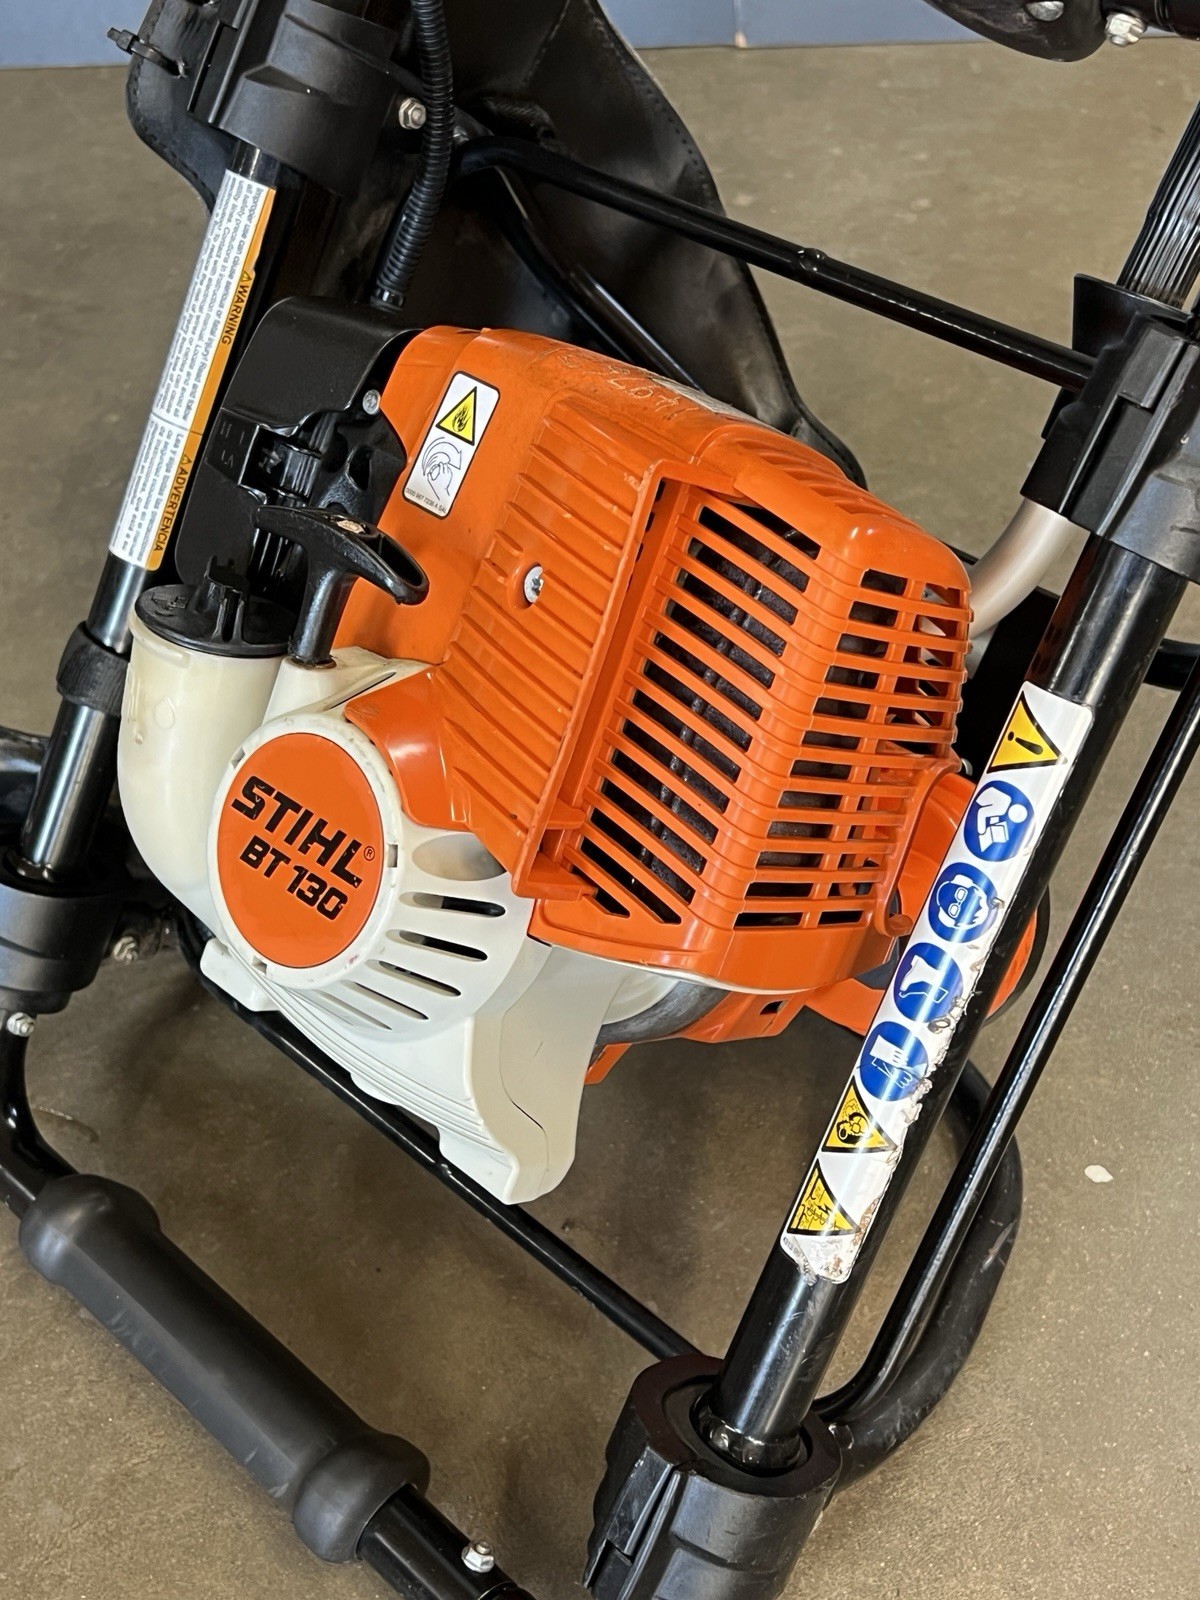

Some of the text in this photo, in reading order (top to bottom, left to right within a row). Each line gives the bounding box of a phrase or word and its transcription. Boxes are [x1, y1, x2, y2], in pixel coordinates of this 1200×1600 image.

[236, 192, 250, 218] safety
[215, 226, 230, 258] Contact
[221, 217, 242, 264] precautions
[241, 223, 249, 239] use
[236, 239, 244, 255] can
[228, 255, 239, 280] cause
[207, 272, 224, 313] instruction
[218, 280, 232, 309] serious
[209, 318, 220, 337] fatal
[222, 285, 250, 346] WARNING
[183, 370, 193, 386] and
[194, 361, 206, 383] Read
[189, 383, 199, 399] and
[173, 433, 183, 449] Lea
[154, 467, 188, 552] ADVERTENCIA
[240, 836, 348, 920] BT 130
